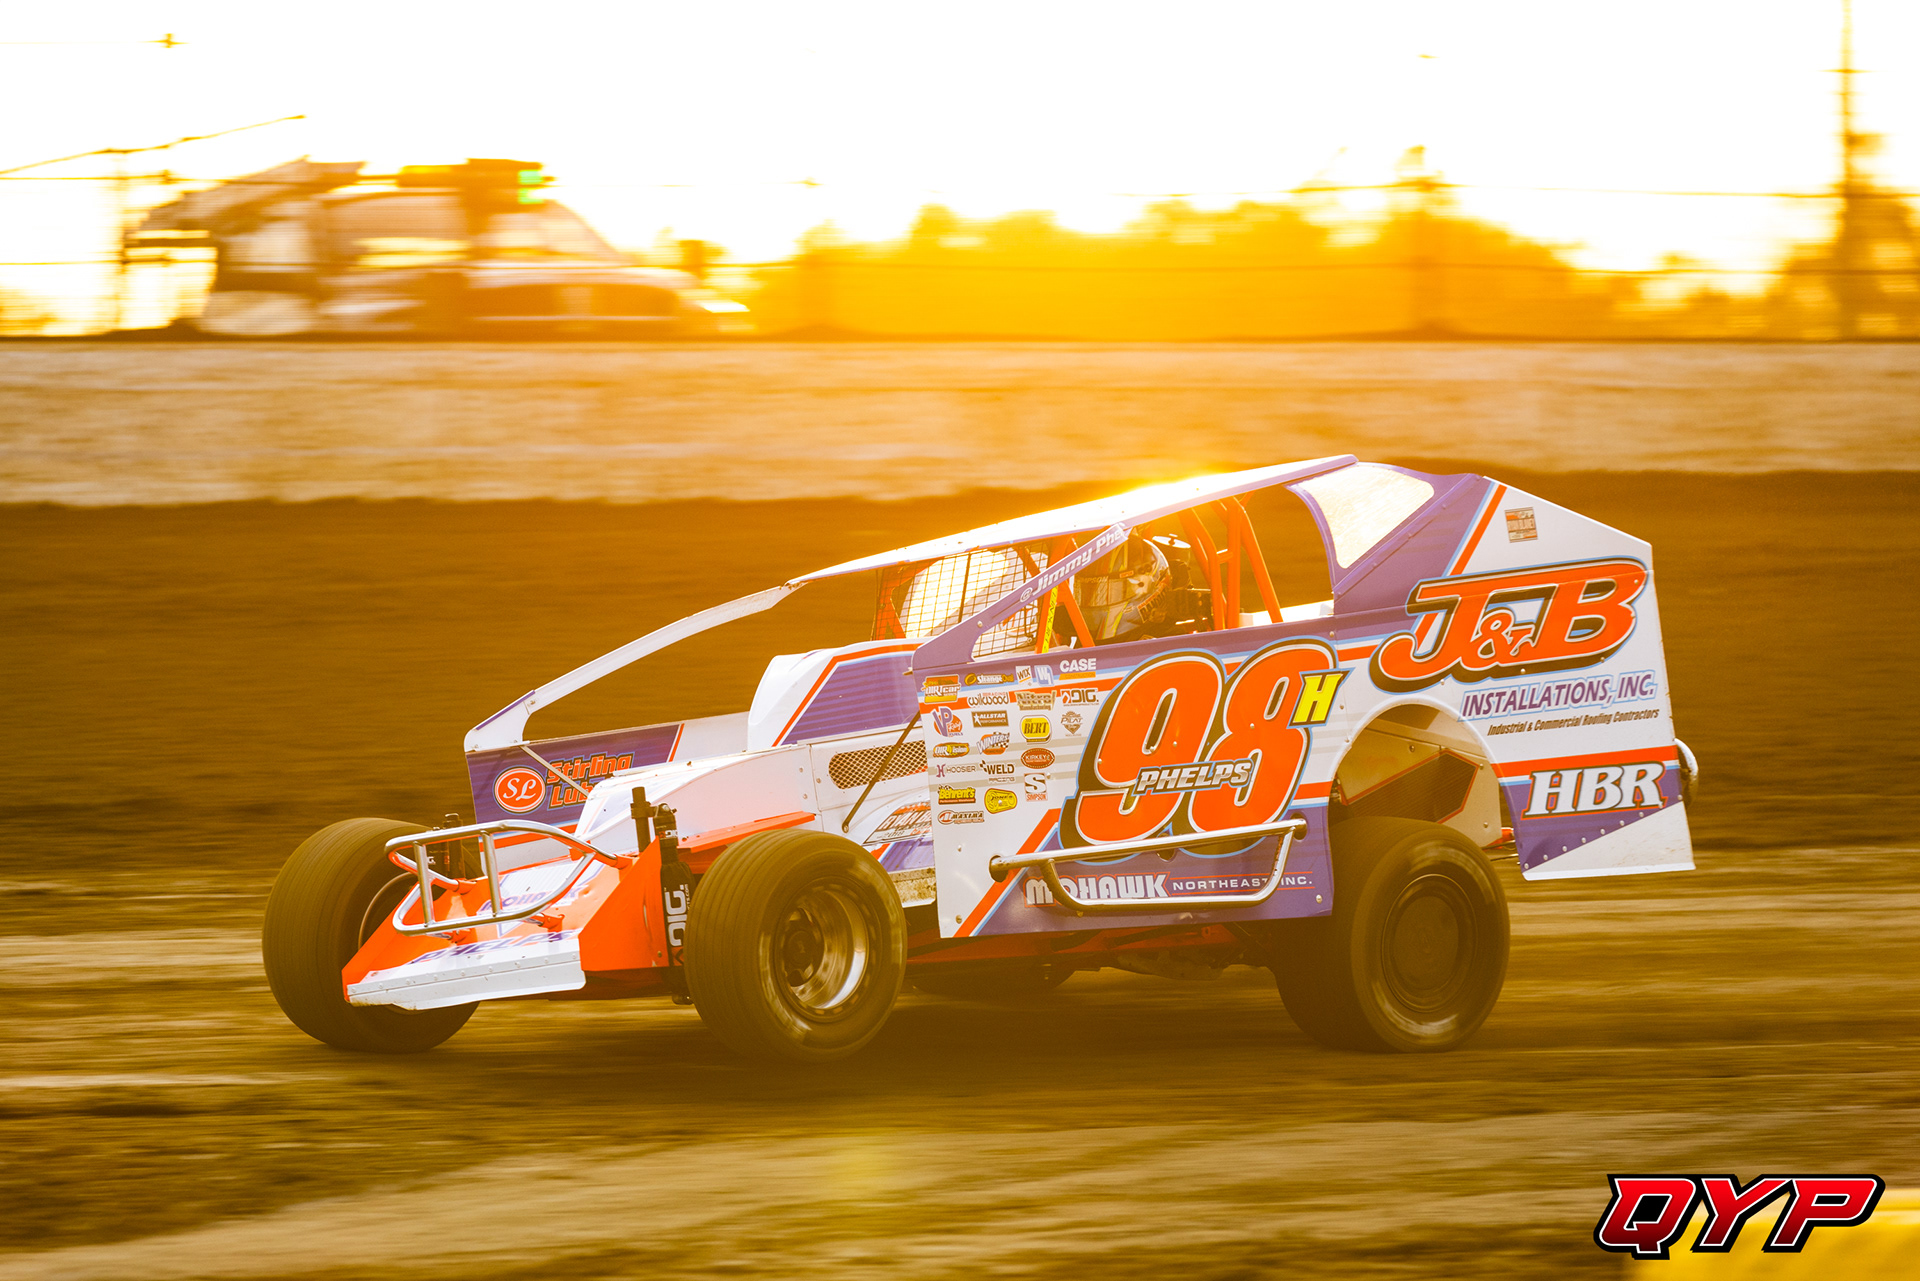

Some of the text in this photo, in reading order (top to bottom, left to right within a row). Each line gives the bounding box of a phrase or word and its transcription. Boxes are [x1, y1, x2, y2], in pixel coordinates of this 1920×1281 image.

[1032, 547, 1093, 596] Jimmy
[1095, 526, 1123, 554] Phe
[1377, 562, 1648, 680] J&B
[1017, 667, 1031, 680] WIX
[1060, 658, 1097, 673] CASE
[968, 692, 1010, 706] wilwood
[1462, 674, 1655, 717] INSTALLATIONS, INC.
[1024, 722, 1050, 735] BERT
[1487, 708, 1660, 737] Industrial & Commercial Roofing Contractors
[1072, 642, 1342, 850] 98 H
[547, 755, 632, 784] Stirling
[946, 765, 976, 773] HOOSIER
[986, 763, 1015, 775] WELD
[1136, 761, 1252, 791] PHELPS
[1026, 792, 1047, 801] SIMPSON
[1523, 761, 1665, 818] HBR
[951, 812, 983, 820] MAXIMA
[1026, 874, 1169, 906] MOHAWK
[1281, 876, 1313, 886] INC.
